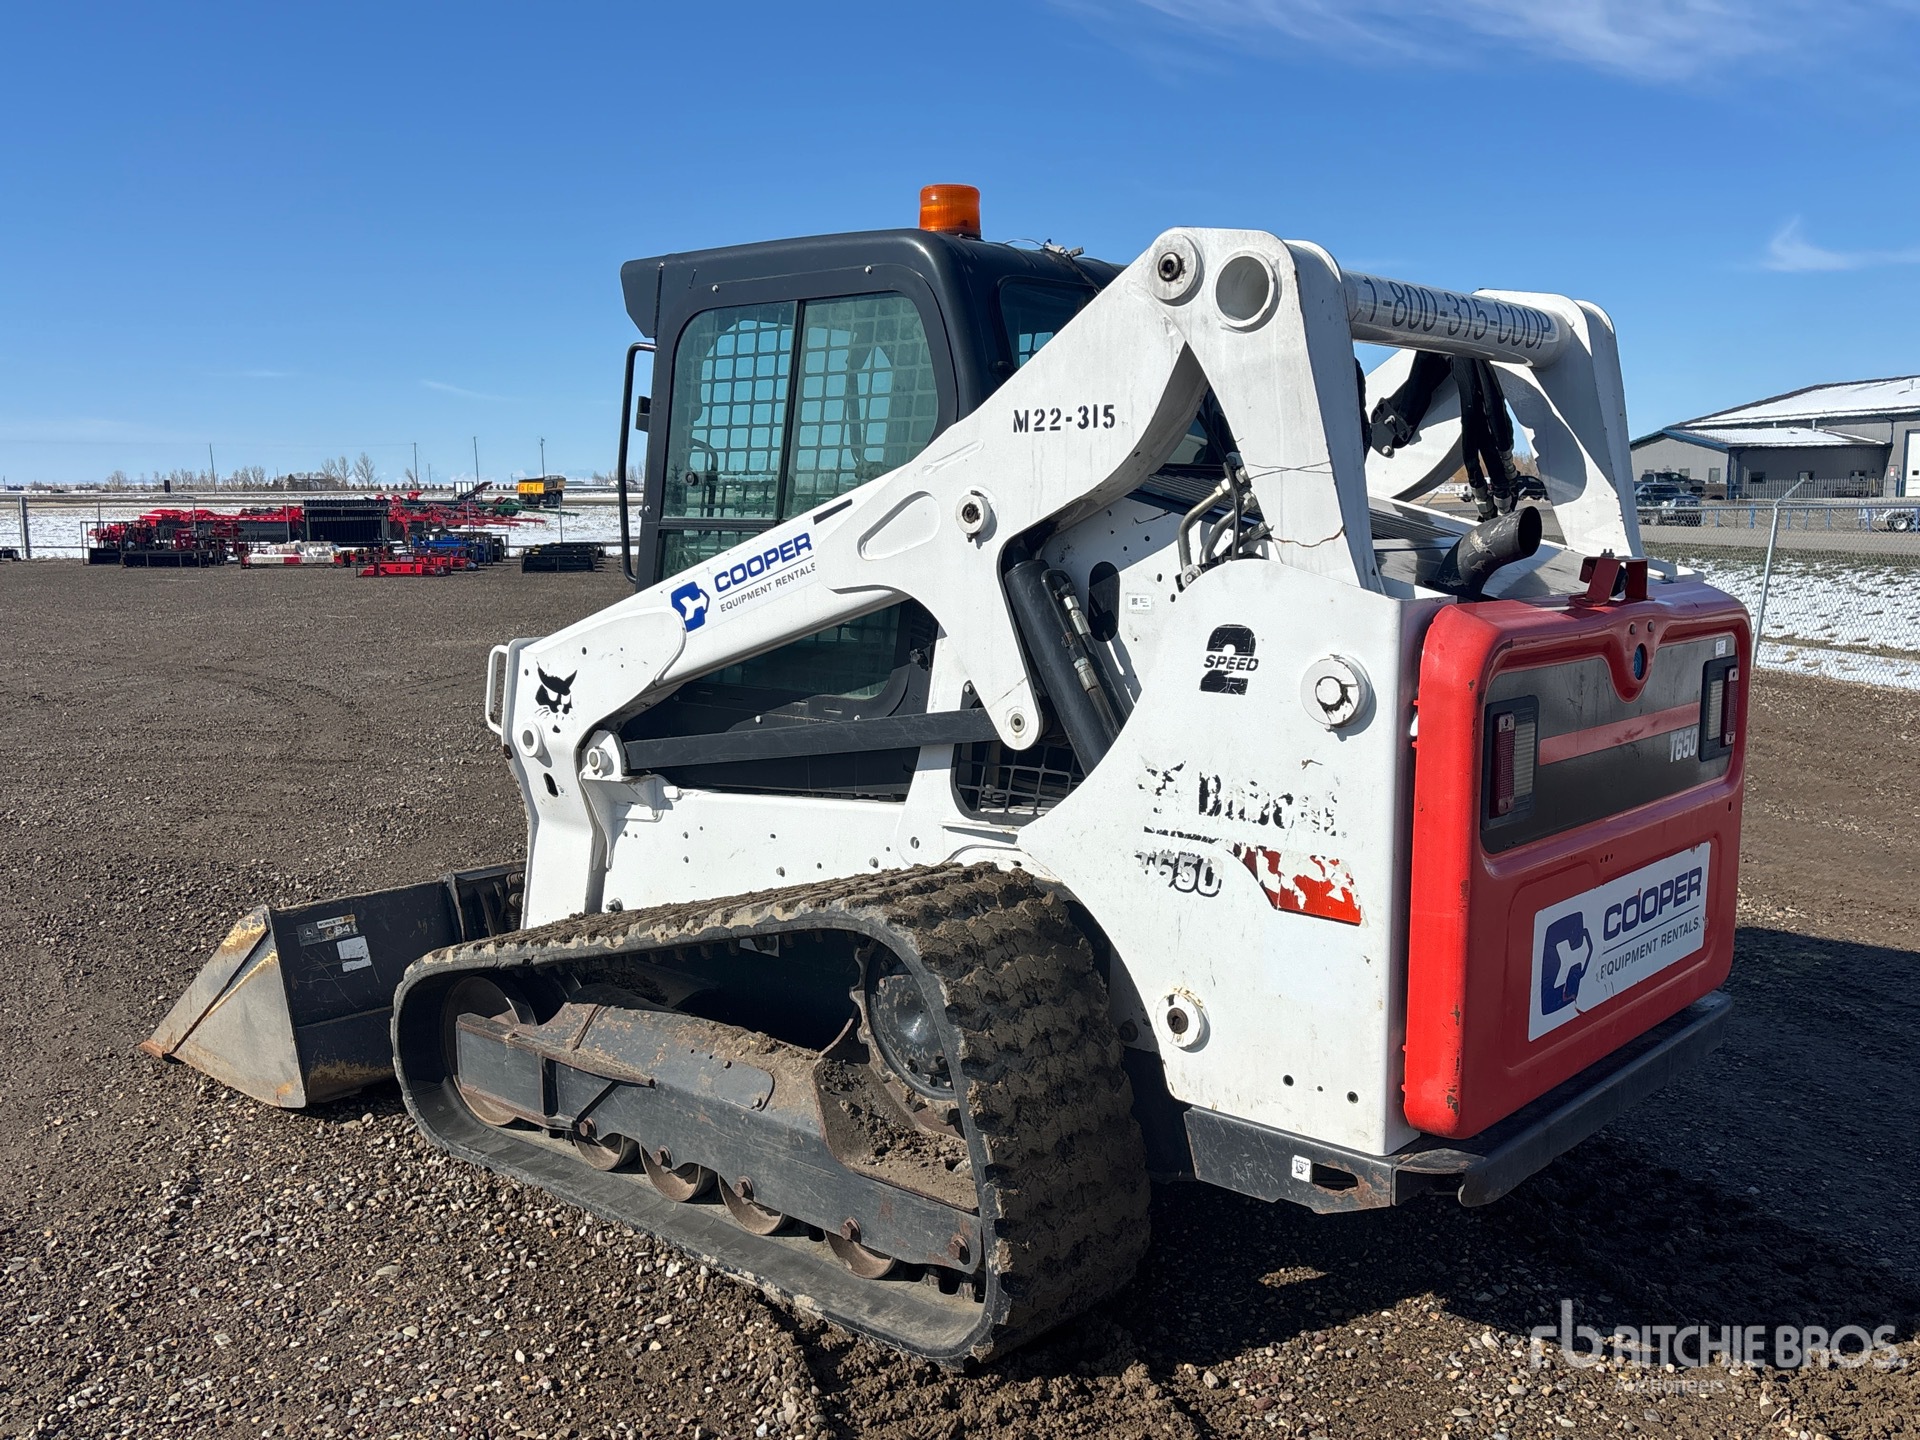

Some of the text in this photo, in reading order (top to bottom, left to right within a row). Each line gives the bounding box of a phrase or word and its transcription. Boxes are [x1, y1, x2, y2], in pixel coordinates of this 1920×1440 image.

[1012, 404, 1116, 433] M22-315
[714, 532, 813, 593] COOPER
[720, 562, 816, 613] EQUIPMENT RENTALS
[1203, 654, 1260, 672] SPEED
[1669, 727, 1698, 763] T650
[1603, 866, 1703, 941] COOPER
[1600, 938, 1658, 979] EQUIPMENT
